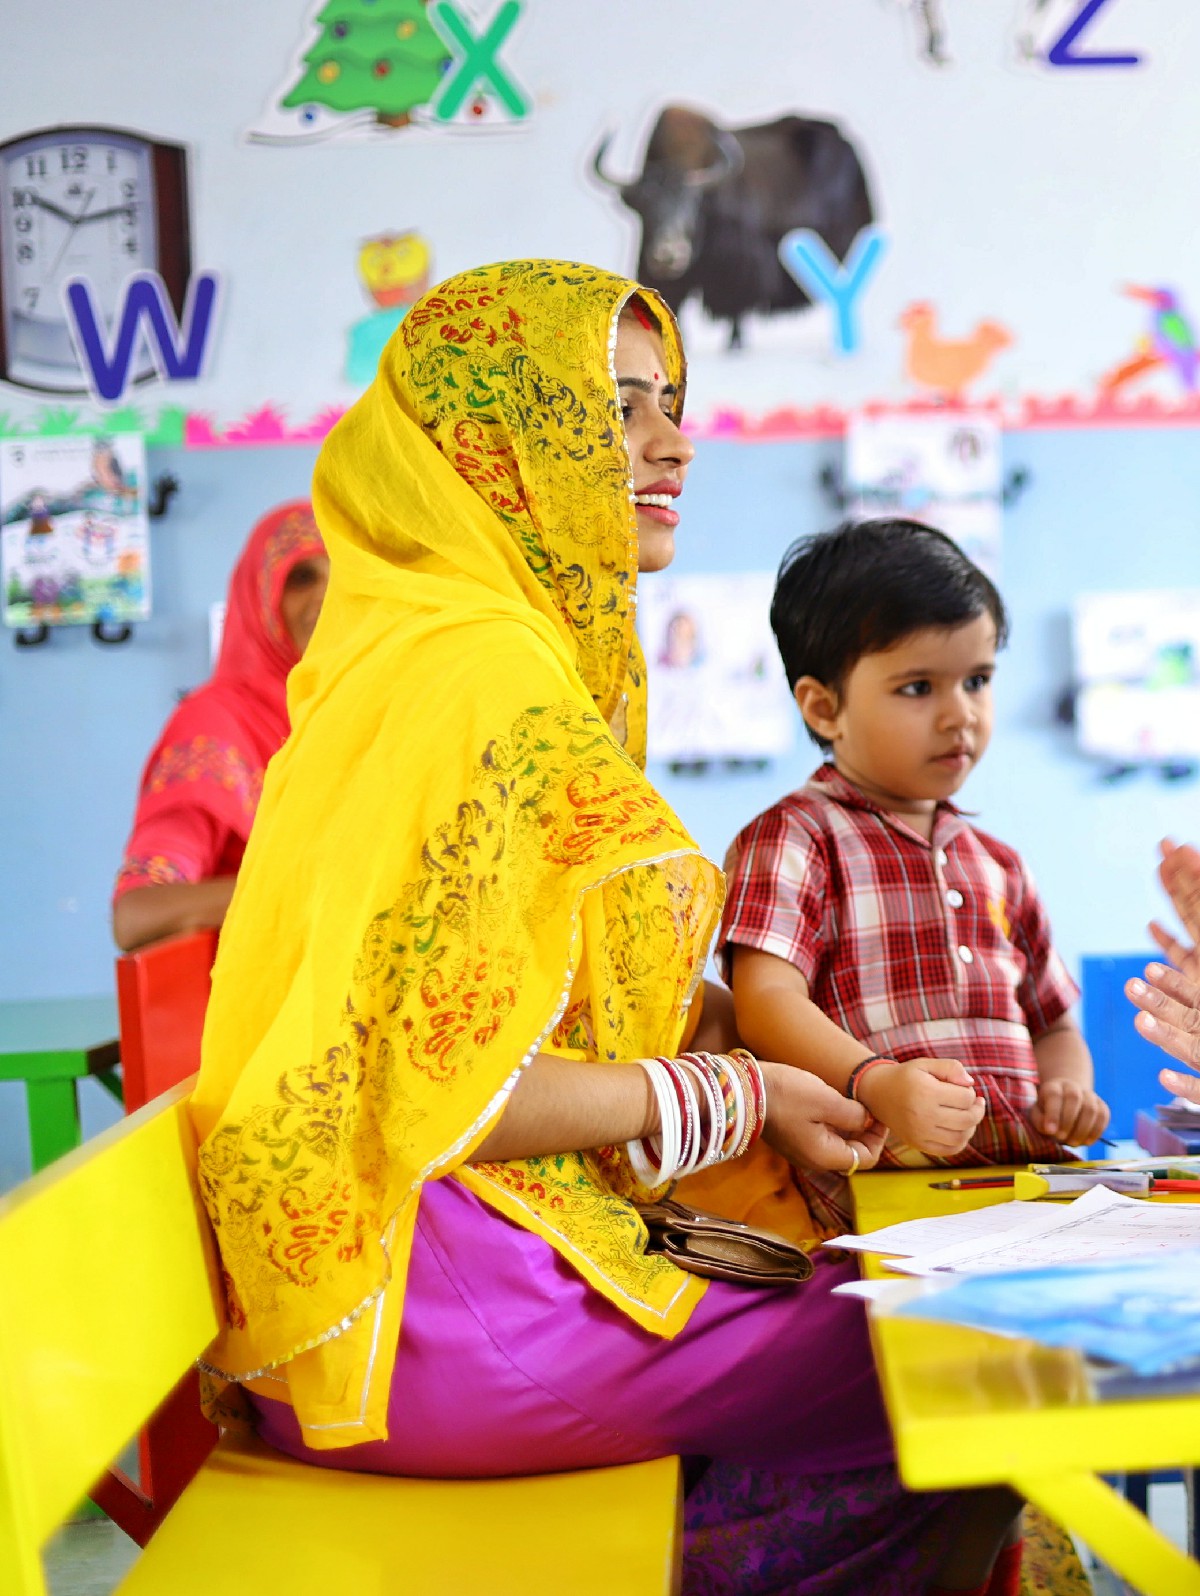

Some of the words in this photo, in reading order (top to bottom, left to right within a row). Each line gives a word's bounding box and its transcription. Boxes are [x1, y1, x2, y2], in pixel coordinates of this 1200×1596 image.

[437, 1, 525, 121] X
[1046, 0, 1140, 65] Z
[27, 153, 47, 177] 11
[61, 146, 89, 173] 12
[106, 150, 117, 174] 1
[781, 229, 887, 355] Y
[67, 276, 216, 400] W
